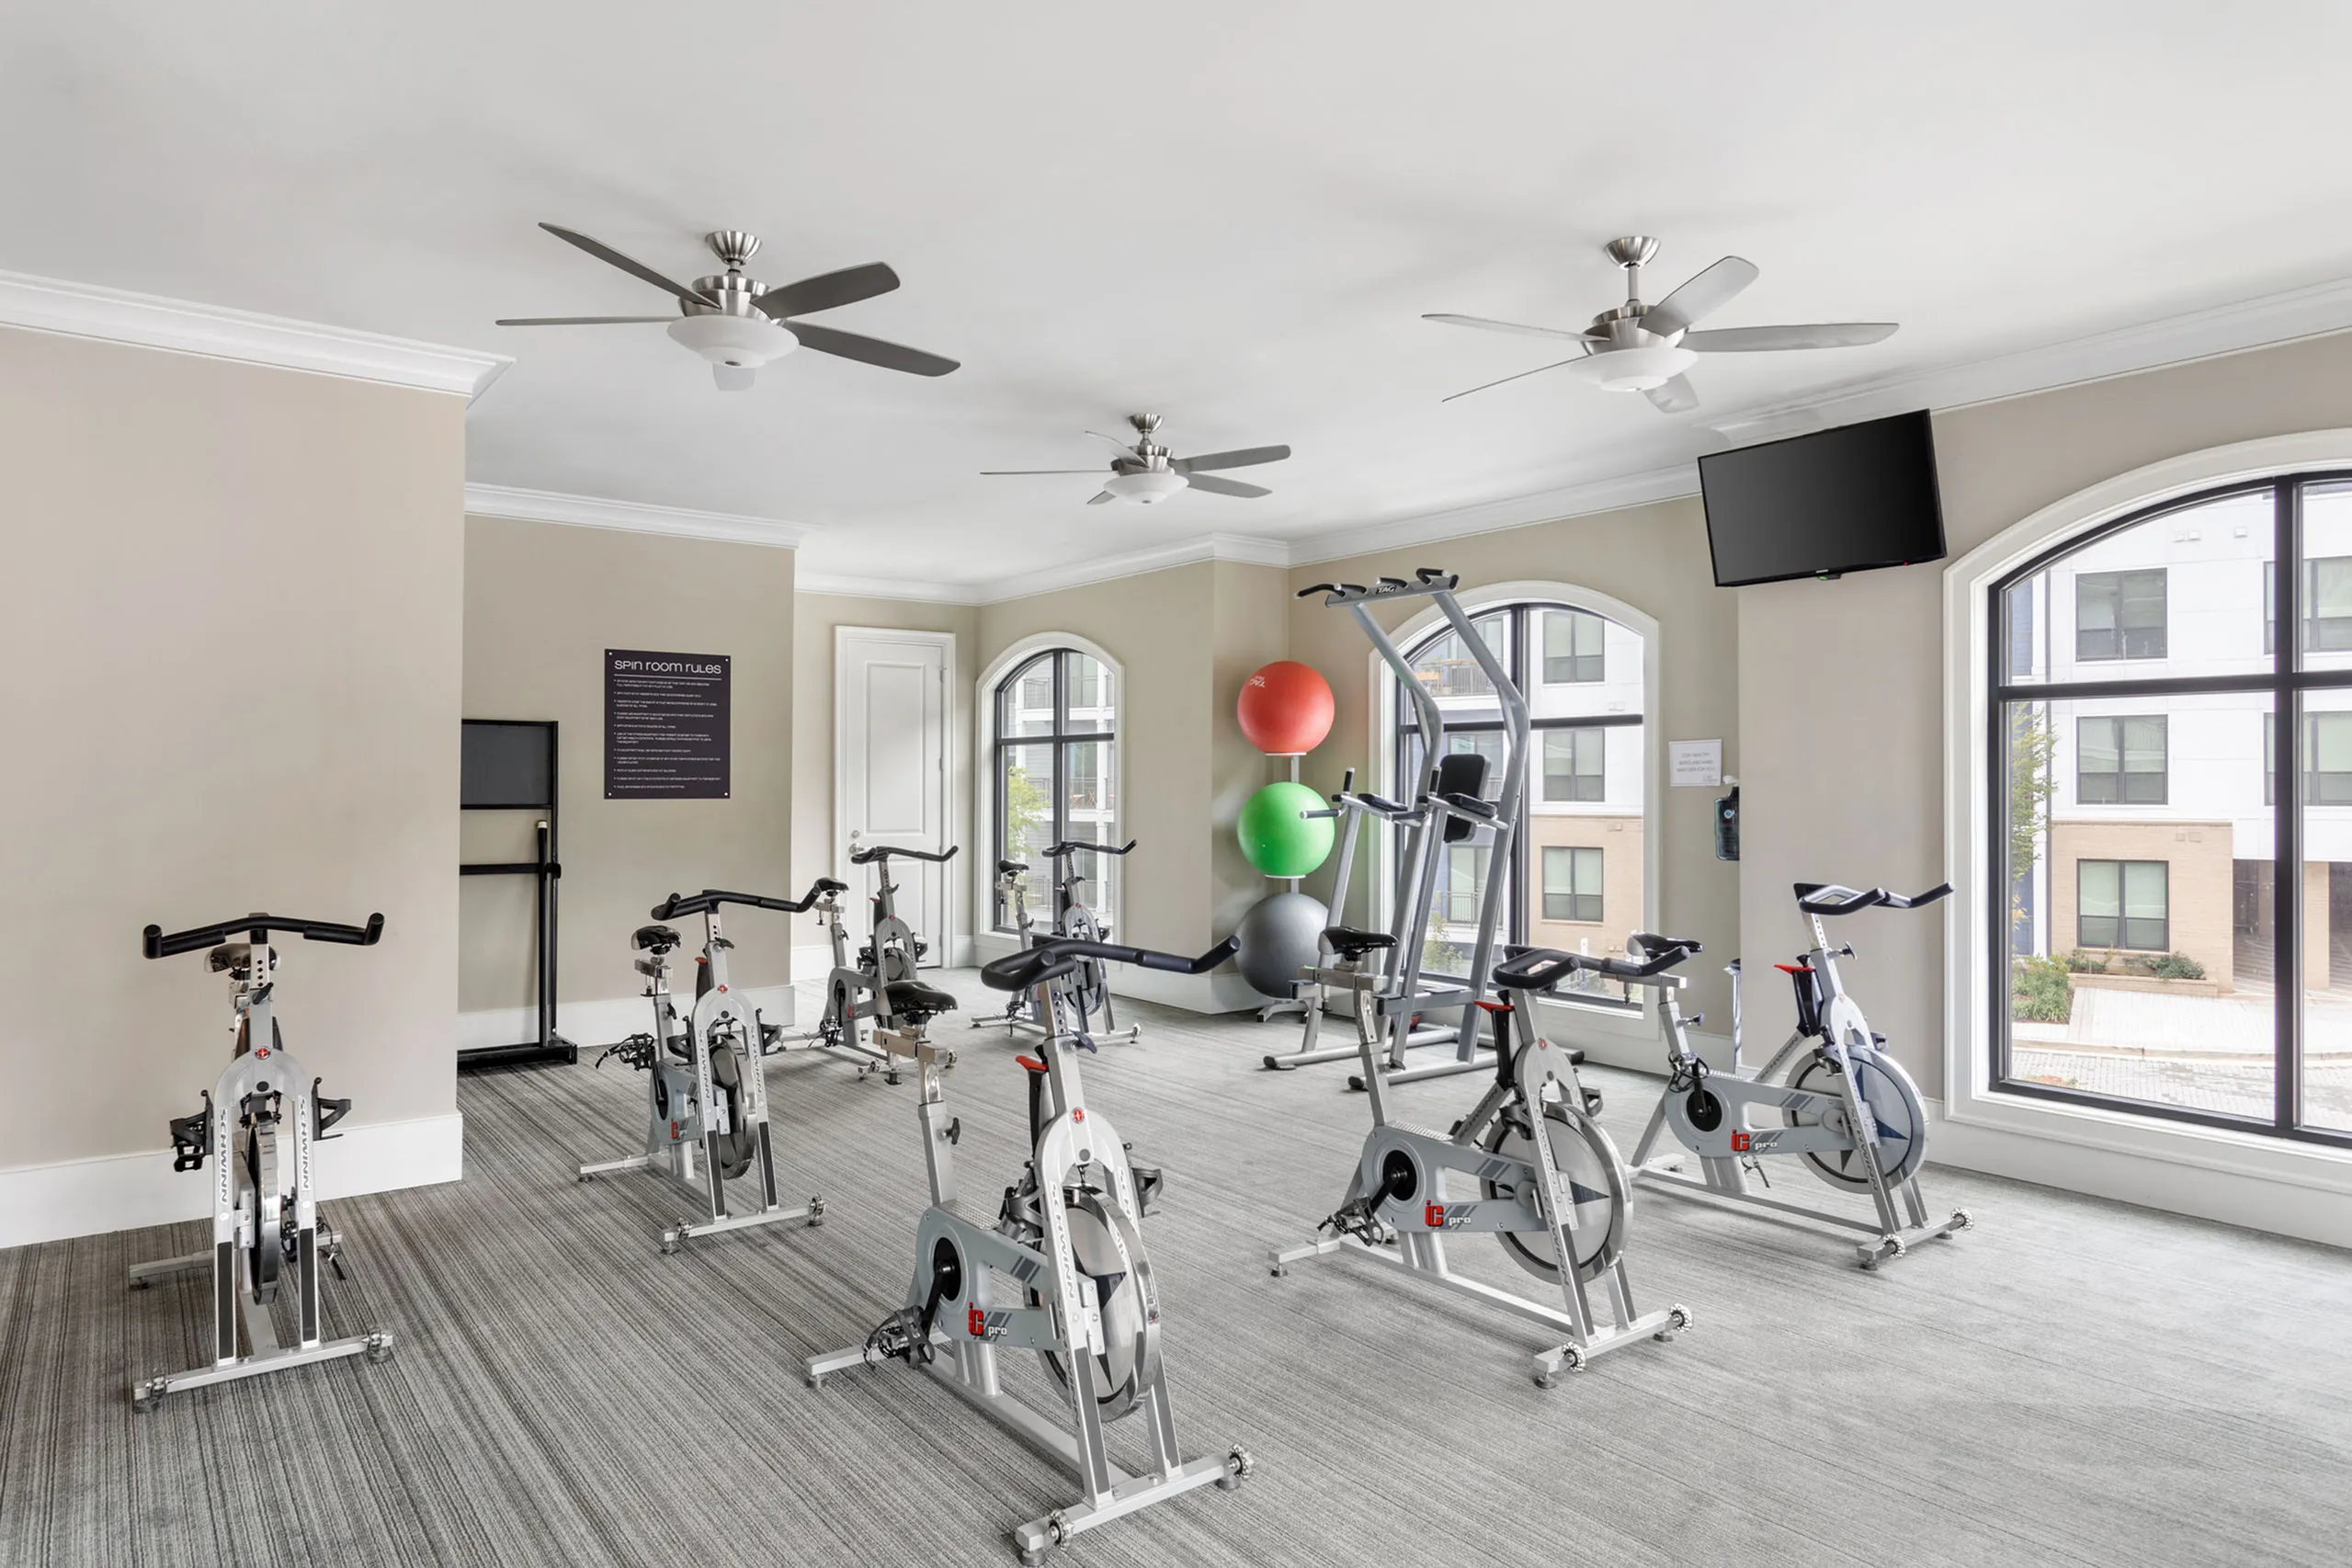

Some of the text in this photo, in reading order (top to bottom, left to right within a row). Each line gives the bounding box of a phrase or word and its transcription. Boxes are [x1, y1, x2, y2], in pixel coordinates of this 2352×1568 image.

[1377, 585, 1395, 594] TAG
[646, 661, 682, 672] room
[1458, 1087, 1499, 1141] SCHWINN
[300, 1098, 310, 1189] SCHWINN
[1755, 1142, 1778, 1151] pro
[220, 1108, 229, 1204] SCHWINN
[1449, 1216, 1471, 1226] pro
[1050, 1183, 1074, 1300] SCHWINN
[988, 1325, 1007, 1337] pro
